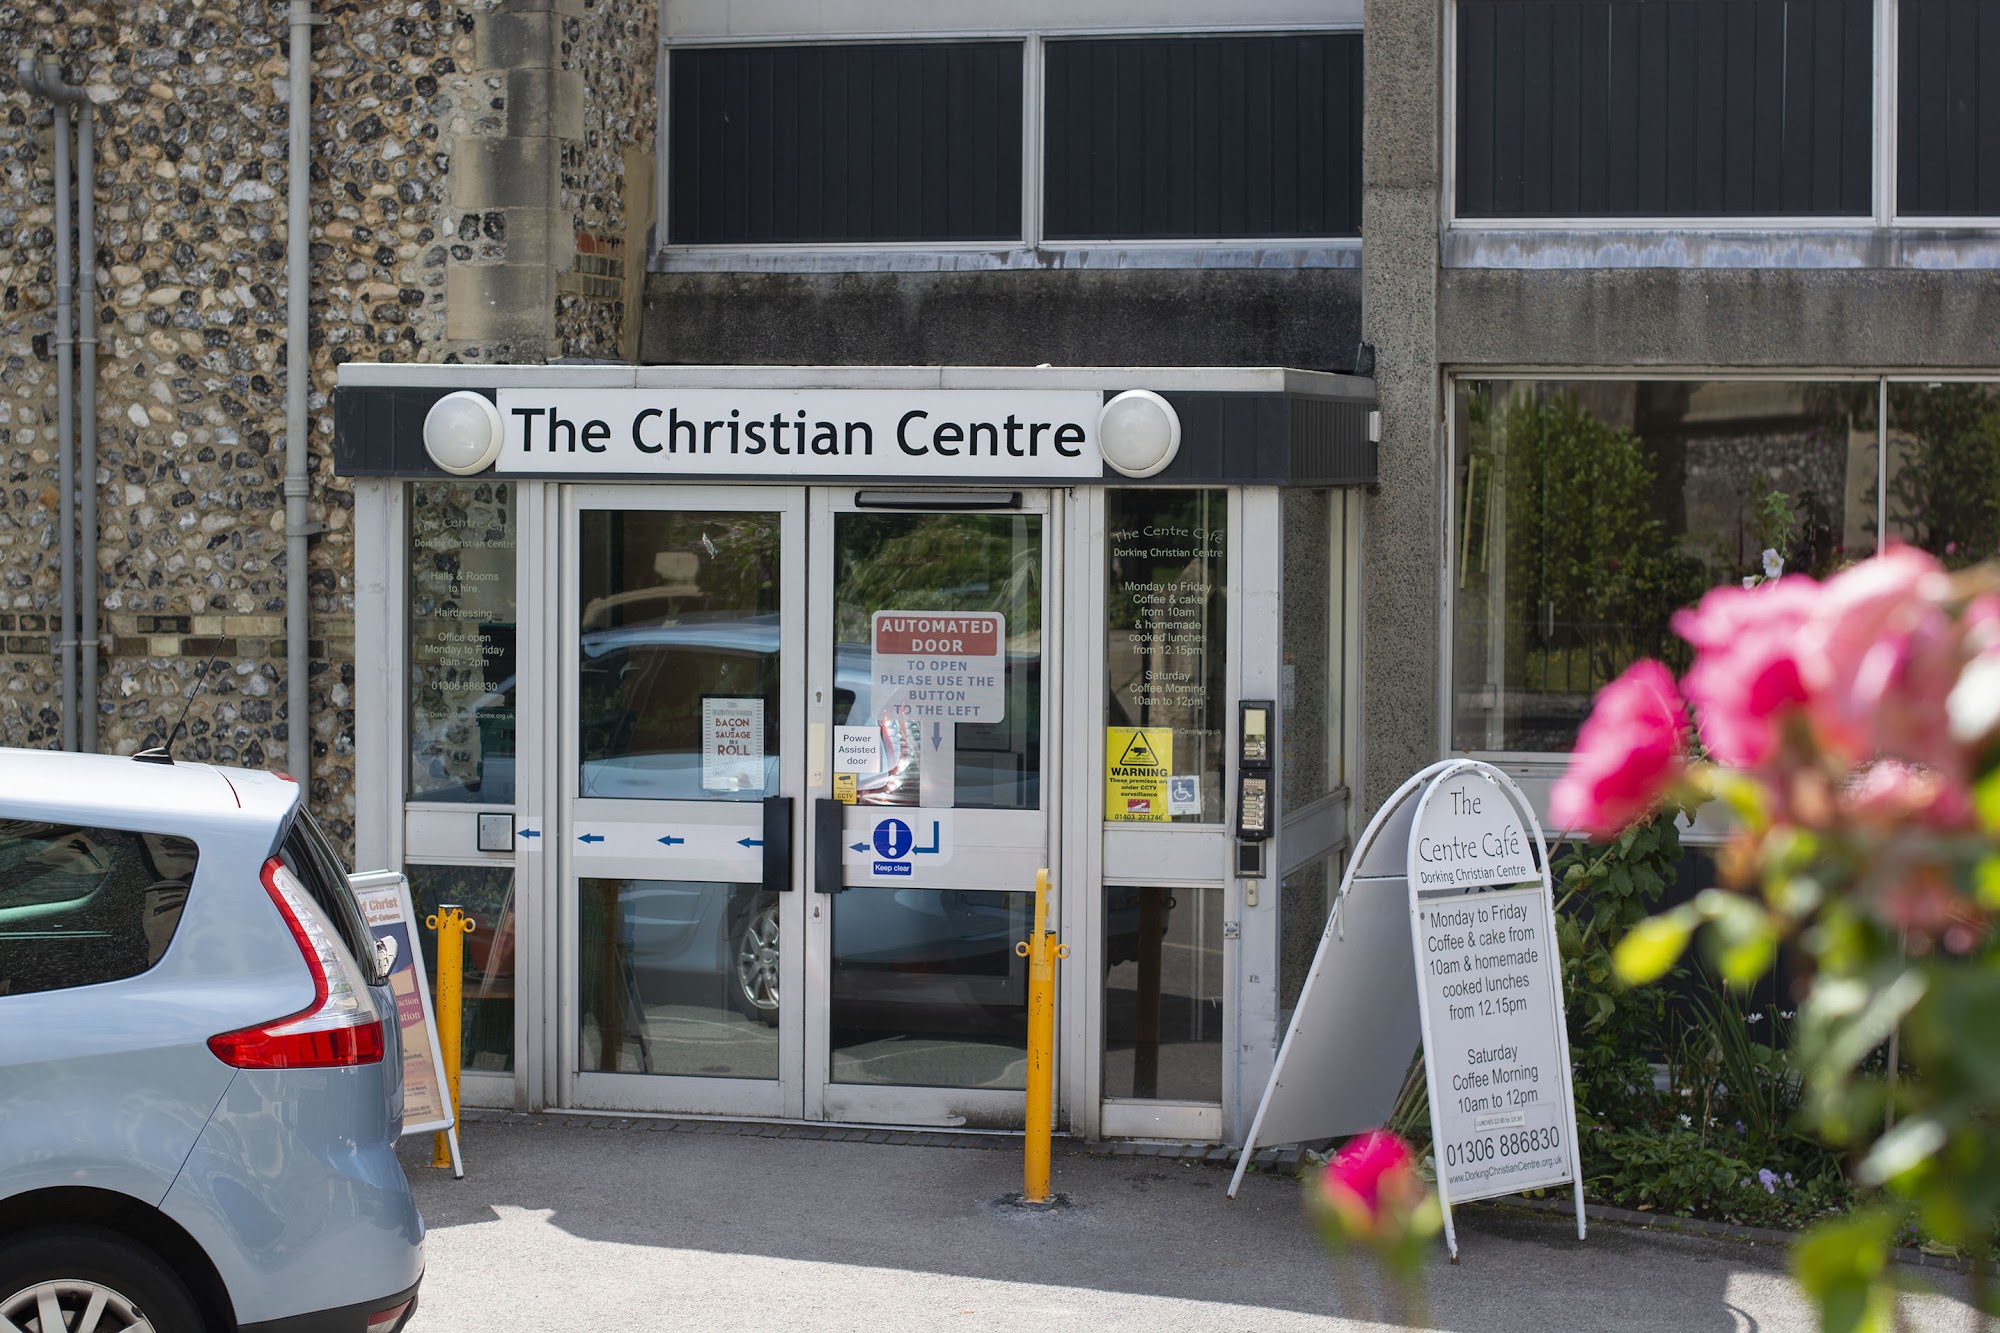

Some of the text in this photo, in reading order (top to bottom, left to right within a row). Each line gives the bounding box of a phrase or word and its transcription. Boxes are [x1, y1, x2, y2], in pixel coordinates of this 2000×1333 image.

[511, 407, 1087, 457] The Christian Centre
[443, 517, 484, 528] Centre
[1113, 528, 1140, 543] The
[1143, 525, 1189, 537] Centre
[414, 539, 515, 548] Dorking Christian Centre
[1114, 548, 1223, 558] Dorking Christian Centre
[430, 571, 499, 581] Halls & Rooms
[449, 584, 480, 593] to hire.
[1125, 582, 1212, 594] Monday to Friday
[1132, 594, 1203, 604] Coffee & cake
[434, 608, 495, 619] Hairdressing.
[1141, 607, 1195, 617] from 10am
[881, 619, 994, 634] AUTOMATED
[1134, 620, 1201, 629] & homemade
[438, 632, 491, 644] Office open
[1129, 632, 1207, 642] cooked lunches
[424, 644, 505, 656] Monday to Friday
[912, 639, 963, 653] DOOR
[1133, 645, 1203, 656] from 12.15pm
[440, 657, 460, 667] 9am
[469, 658, 489, 668] 2pm
[907, 660, 967, 671] TO OPEN
[880, 675, 994, 687] PLEASE USE THE
[1145, 670, 1190, 681] Saturday
[431, 681, 498, 691] 01306 886830
[1130, 683, 1206, 695] Coffee Morning
[909, 690, 965, 701] BUTTON
[1132, 696, 1203, 707] 10am to 12pm
[894, 704, 980, 716] TO THE LEFT
[715, 718, 749, 727] BACON
[715, 731, 751, 739] SAUSAGE
[843, 734, 871, 743] Power
[717, 745, 750, 756] ROLL
[838, 745, 876, 754] Assisted
[847, 757, 867, 765] door
[1111, 767, 1168, 777] WARNING
[1450, 786, 1481, 816] The
[1419, 825, 1519, 863] Centre Café
[875, 864, 910, 872] Keep clear
[1420, 865, 1526, 884] Dorking Christian Centre
[369, 896, 398, 911] Christ
[1430, 904, 1527, 928] Monday to Friday
[1428, 927, 1535, 952] Coffee & cake from
[1430, 948, 1539, 976] 10am & homemade
[1442, 973, 1530, 998] cooked lunches
[1449, 997, 1527, 1020] from 12.15pm
[1467, 1045, 1518, 1064] Saturday
[1453, 1065, 1538, 1091] Coffee Morning
[1458, 1089, 1538, 1113] 10am to 12pm
[1447, 1126, 1560, 1167] 01306 886830
[1449, 1155, 1563, 1184] www.DorkingChristianCentre.org.uk
